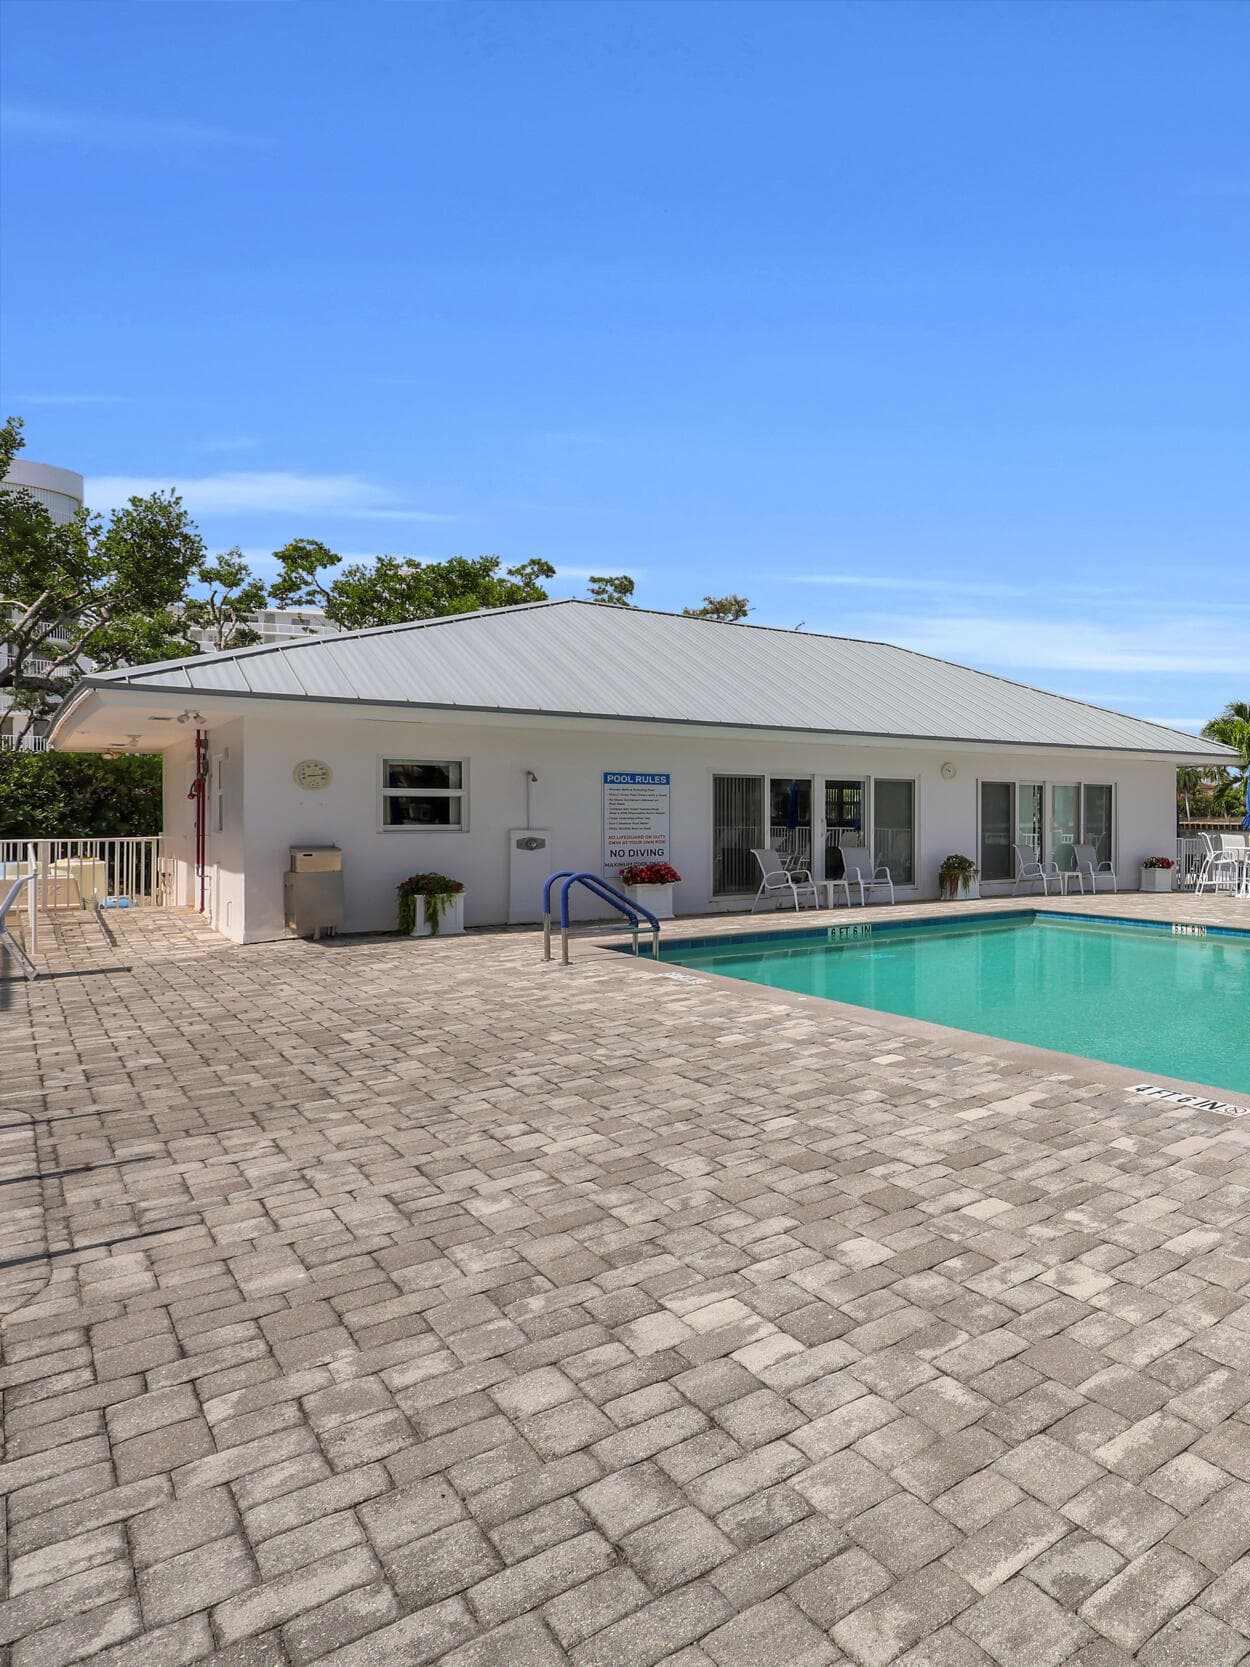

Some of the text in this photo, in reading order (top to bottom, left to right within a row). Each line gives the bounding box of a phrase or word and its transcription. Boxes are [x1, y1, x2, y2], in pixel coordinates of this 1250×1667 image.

[608, 775, 666, 784] POOL RULES
[610, 848, 665, 857] NO DIVING
[1147, 1089, 1182, 1099] FT
[1193, 1100, 1227, 1110] IN
